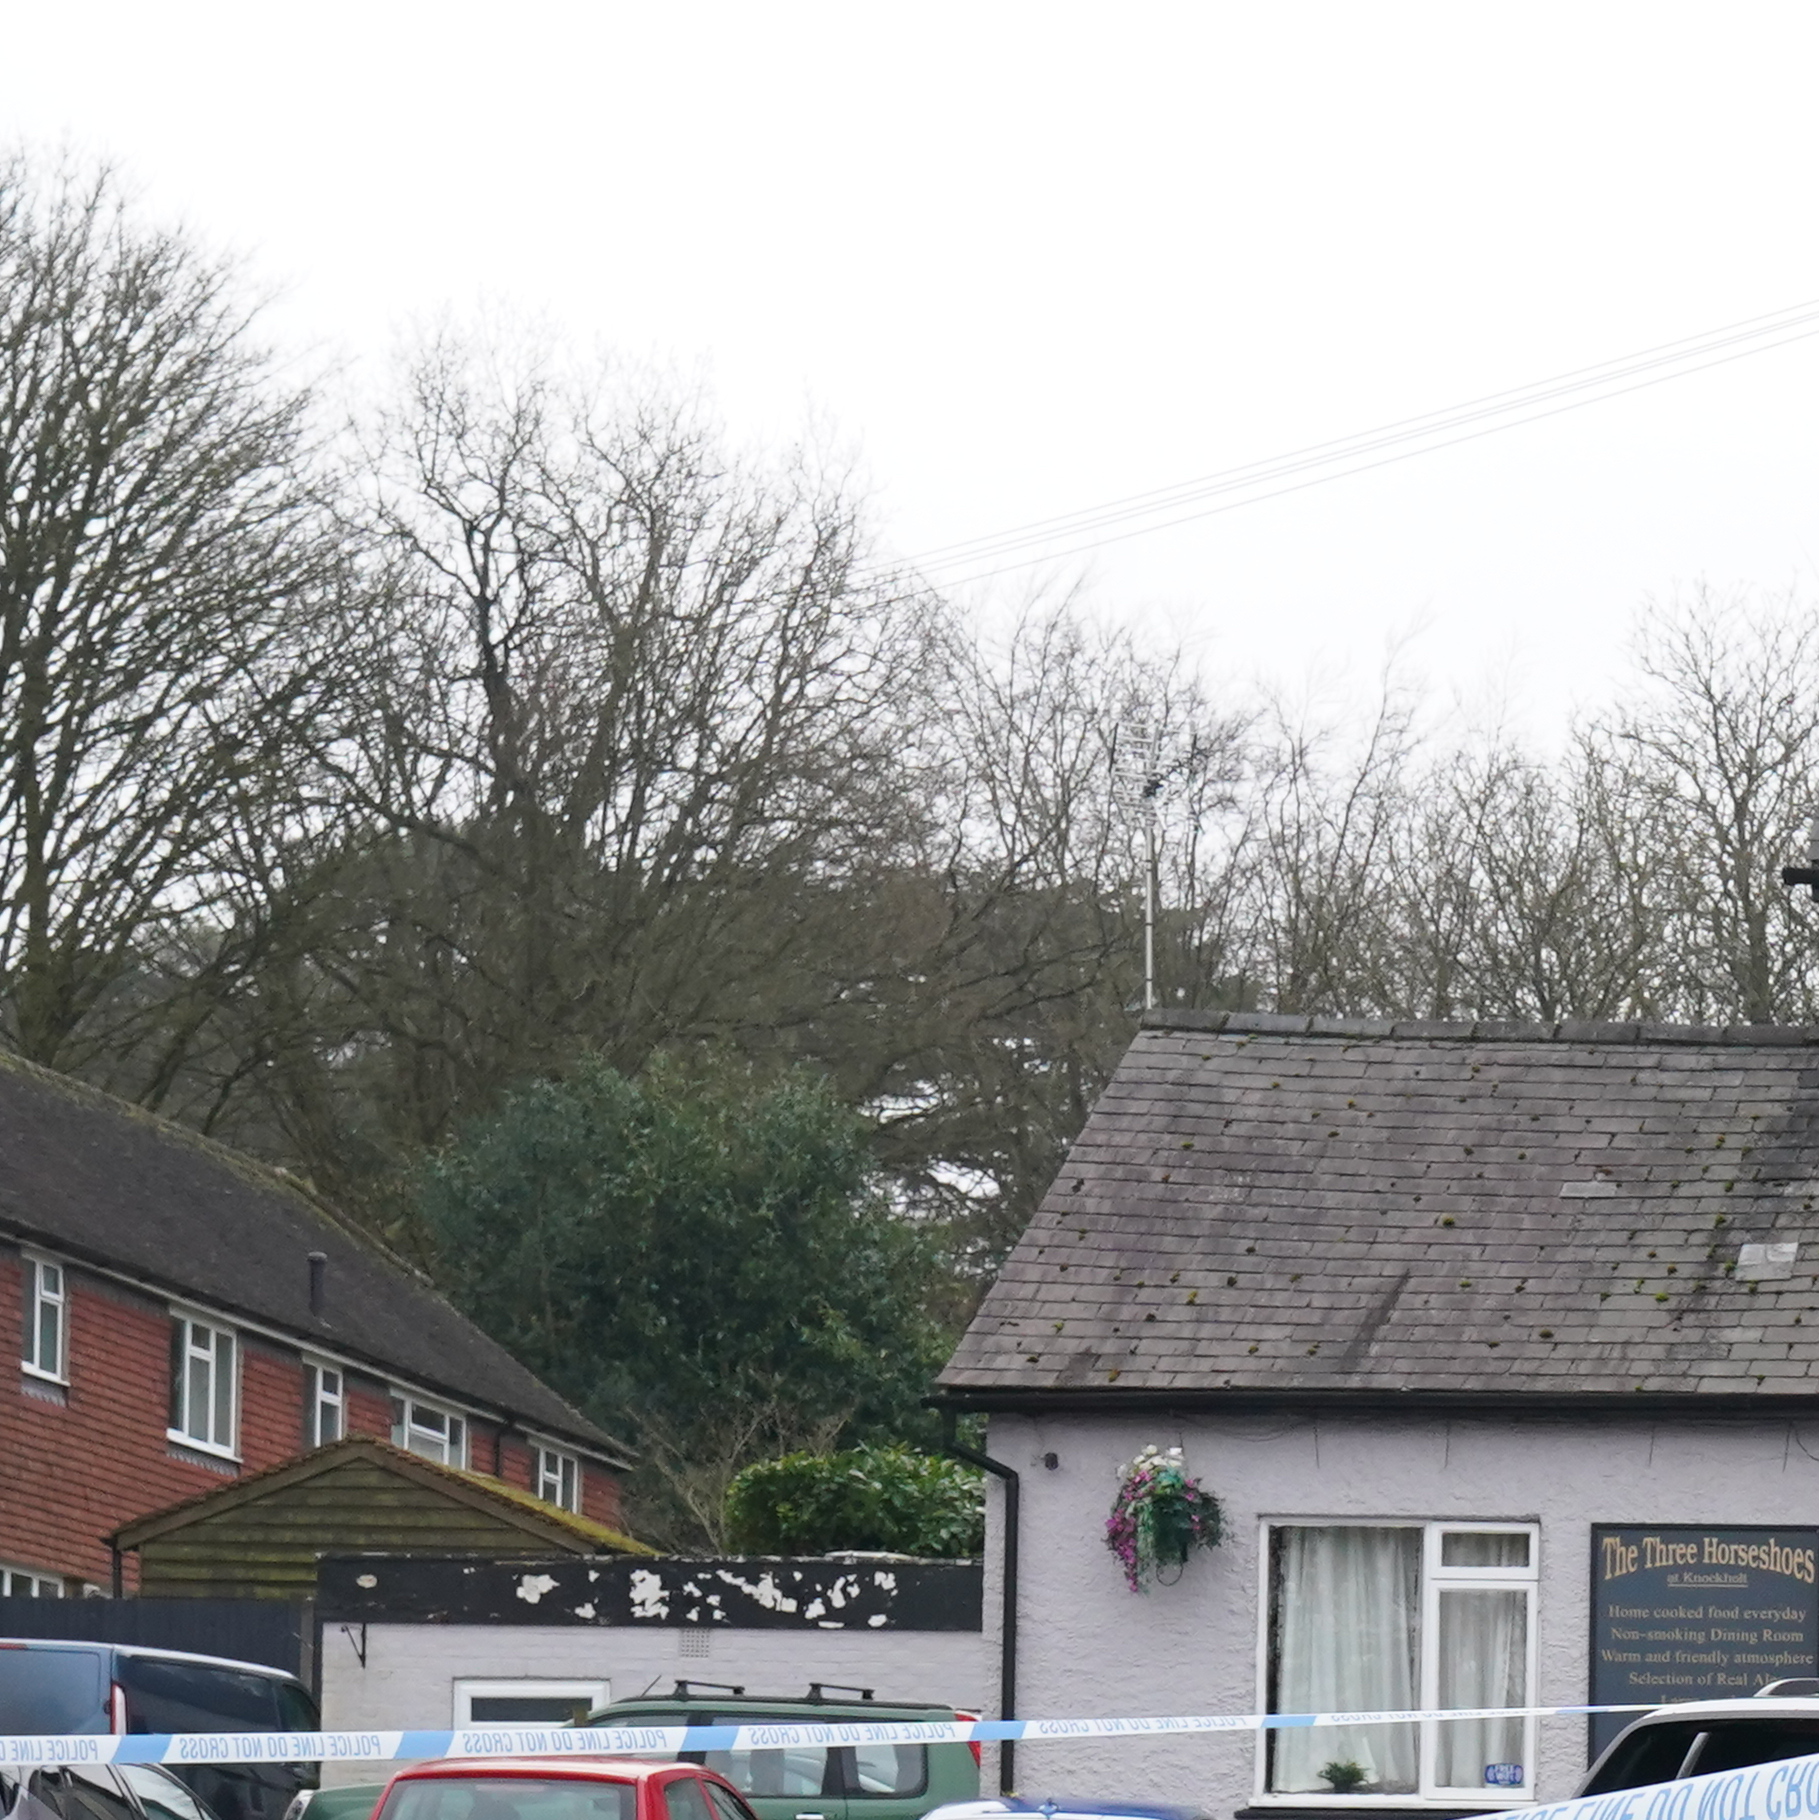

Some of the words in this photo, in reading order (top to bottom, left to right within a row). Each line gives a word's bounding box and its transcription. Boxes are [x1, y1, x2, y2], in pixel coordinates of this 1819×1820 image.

[1602, 1536, 1639, 1580] The
[1642, 1536, 1699, 1569] Three
[1702, 1537, 1816, 1585] Horseshoes
[1609, 1605, 1650, 1619] Home
[1653, 1605, 1704, 1619] cooked
[1707, 1606, 1740, 1619] food
[1743, 1607, 1807, 1623] everyday
[1611, 1627, 1706, 1645] Non-smoking
[1710, 1628, 1759, 1645] Dining
[1762, 1629, 1805, 1643] Room
[1601, 1649, 1642, 1663] Warm
[1645, 1650, 1671, 1664] and
[1674, 1650, 1730, 1667] friendly
[1733, 1652, 1815, 1668] atmosphere
[1629, 1672, 1694, 1686] Selection
[1696, 1673, 1715, 1686] of
[1717, 1673, 1749, 1687] Real
